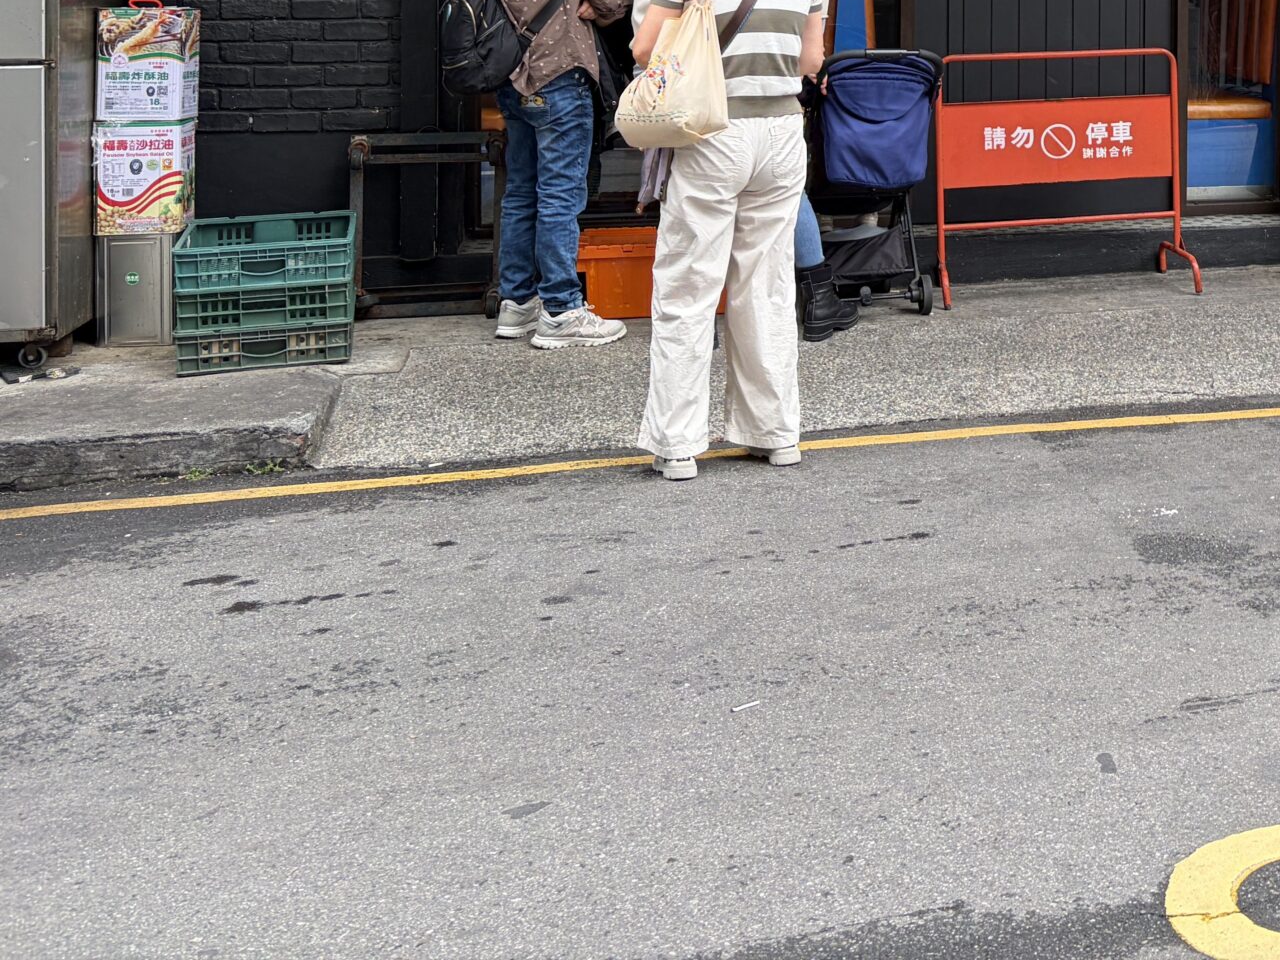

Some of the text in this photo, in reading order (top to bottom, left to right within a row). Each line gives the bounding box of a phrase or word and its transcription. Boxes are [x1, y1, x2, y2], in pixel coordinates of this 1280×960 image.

[149, 98, 160, 106] 18
[983, 126, 1035, 151] 請勿
[1085, 121, 1134, 145] 停車
[1082, 146, 1134, 160] 謝謝合作
